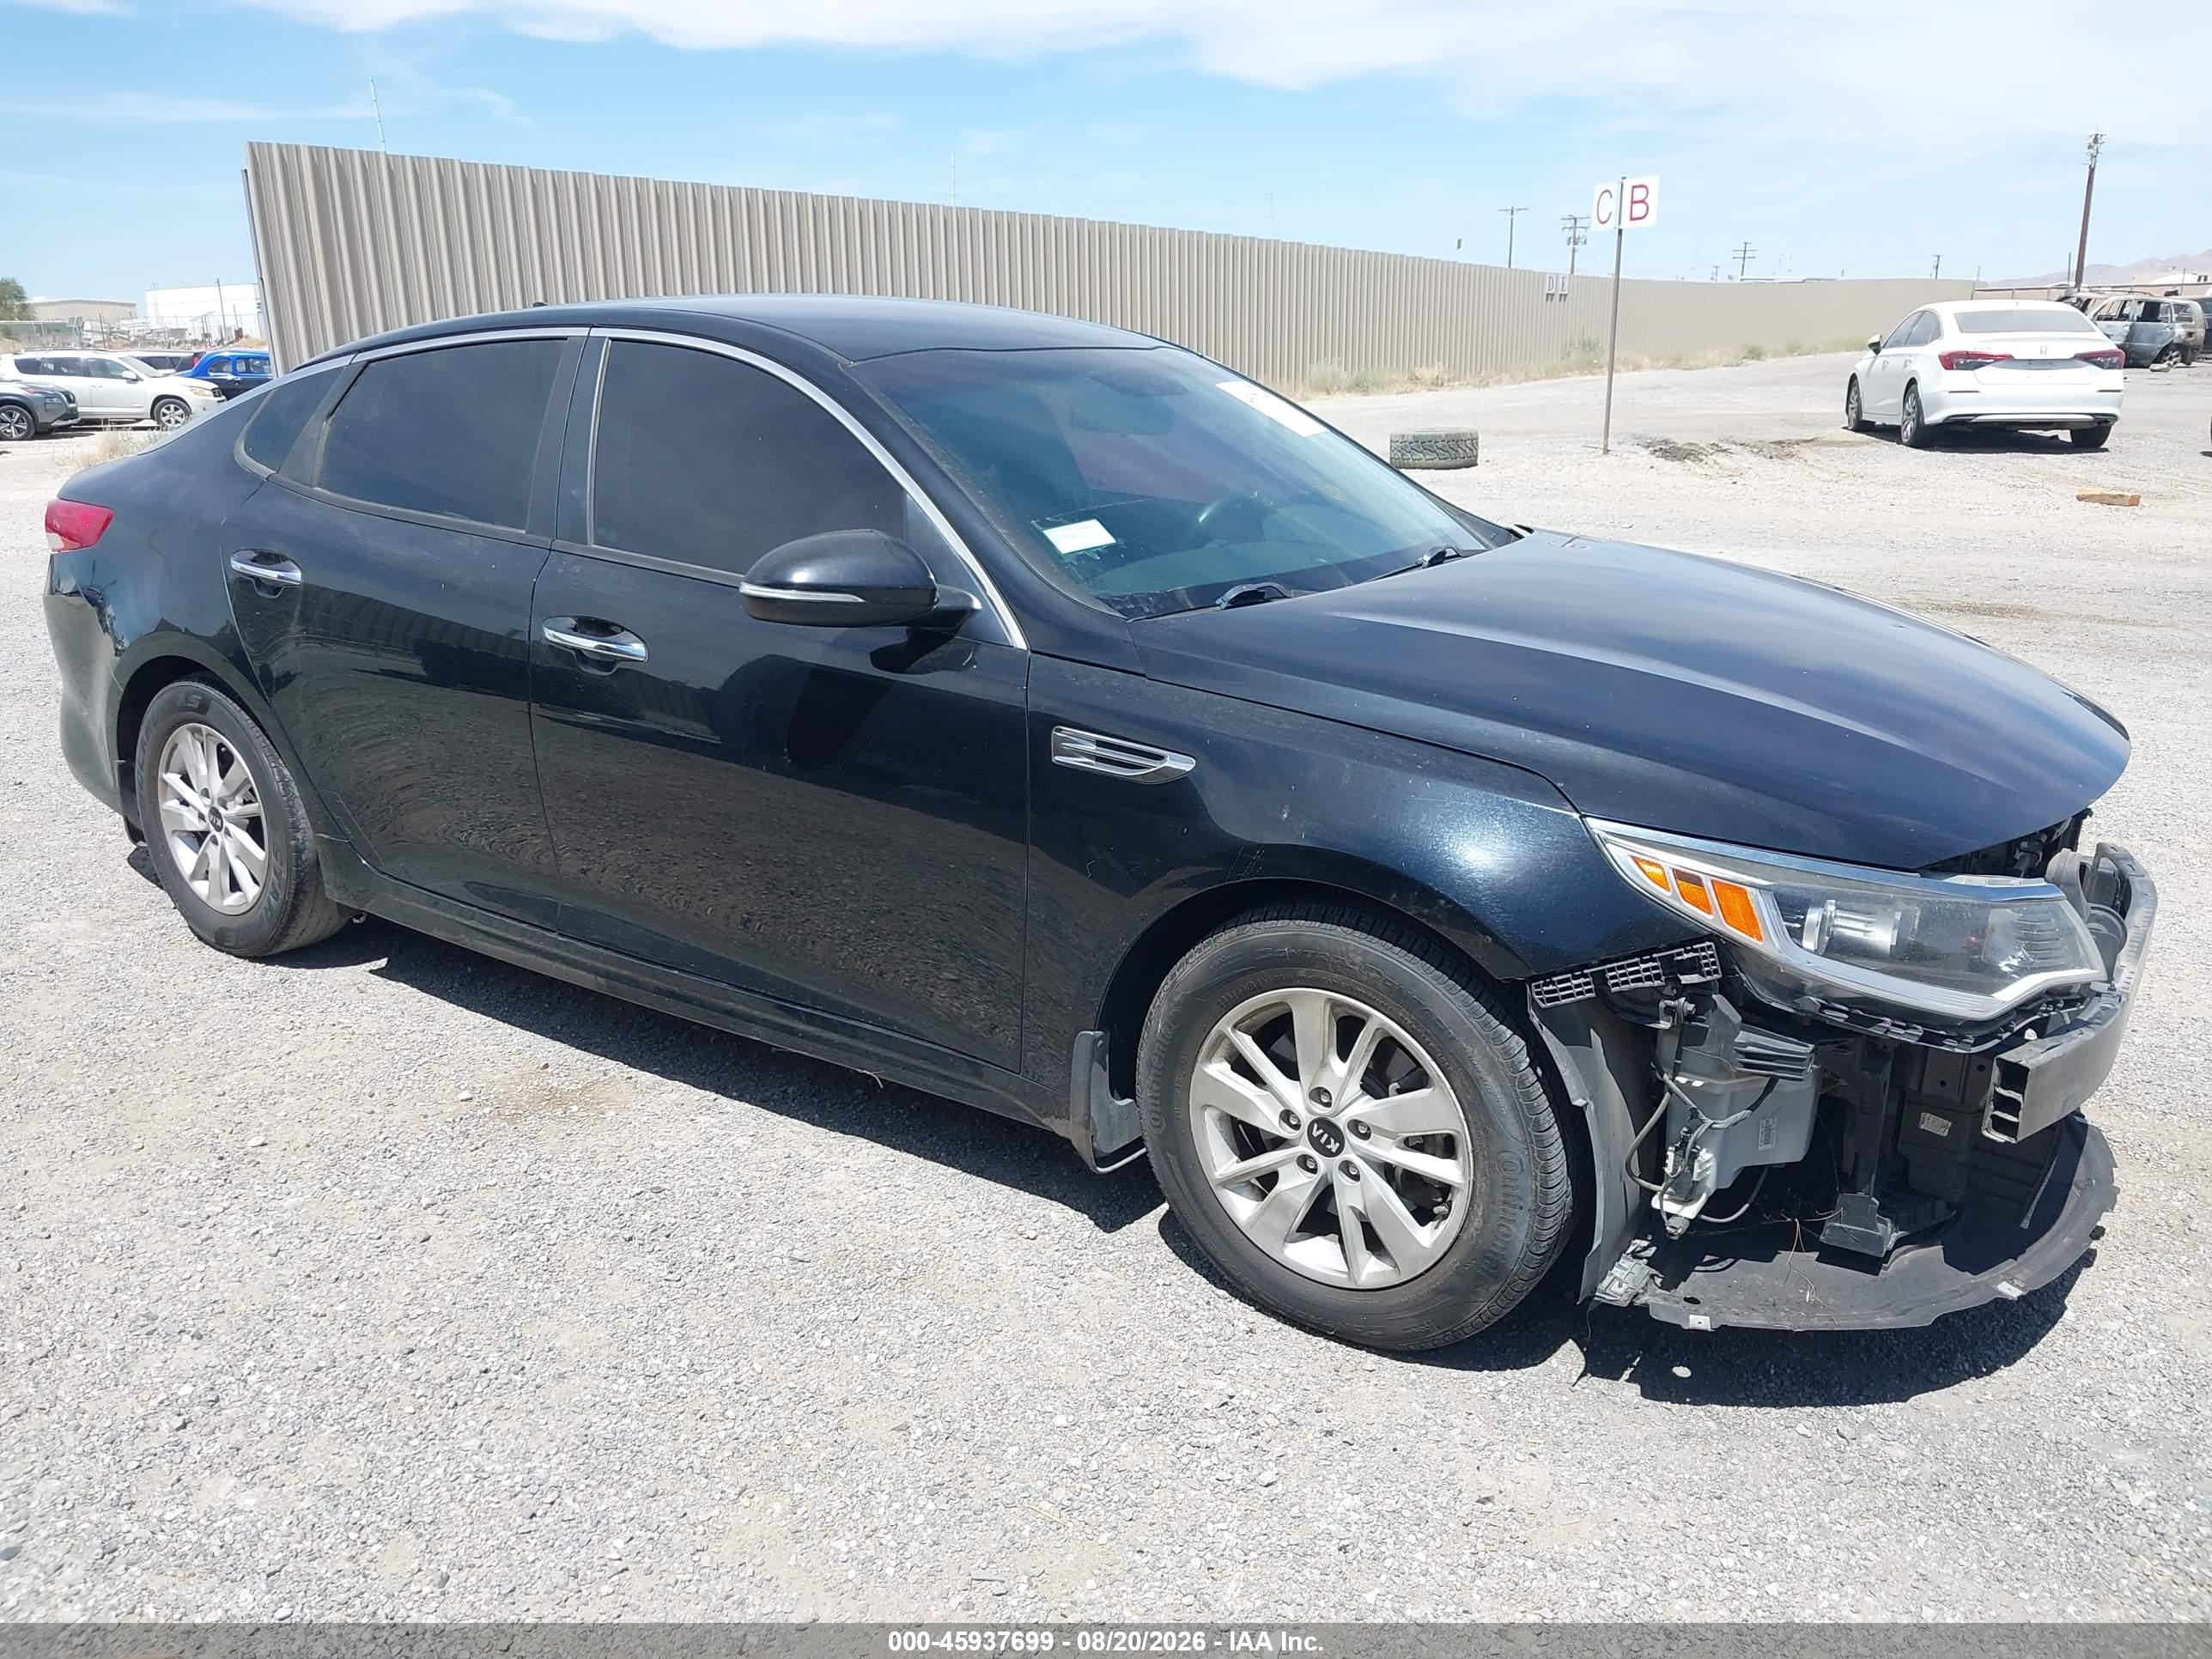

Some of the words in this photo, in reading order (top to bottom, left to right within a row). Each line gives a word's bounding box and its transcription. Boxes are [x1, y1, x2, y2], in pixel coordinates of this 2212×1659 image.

[1596, 188, 1613, 225] C
[1629, 183, 1650, 222] B
[1312, 1122, 1340, 1153] KIA
